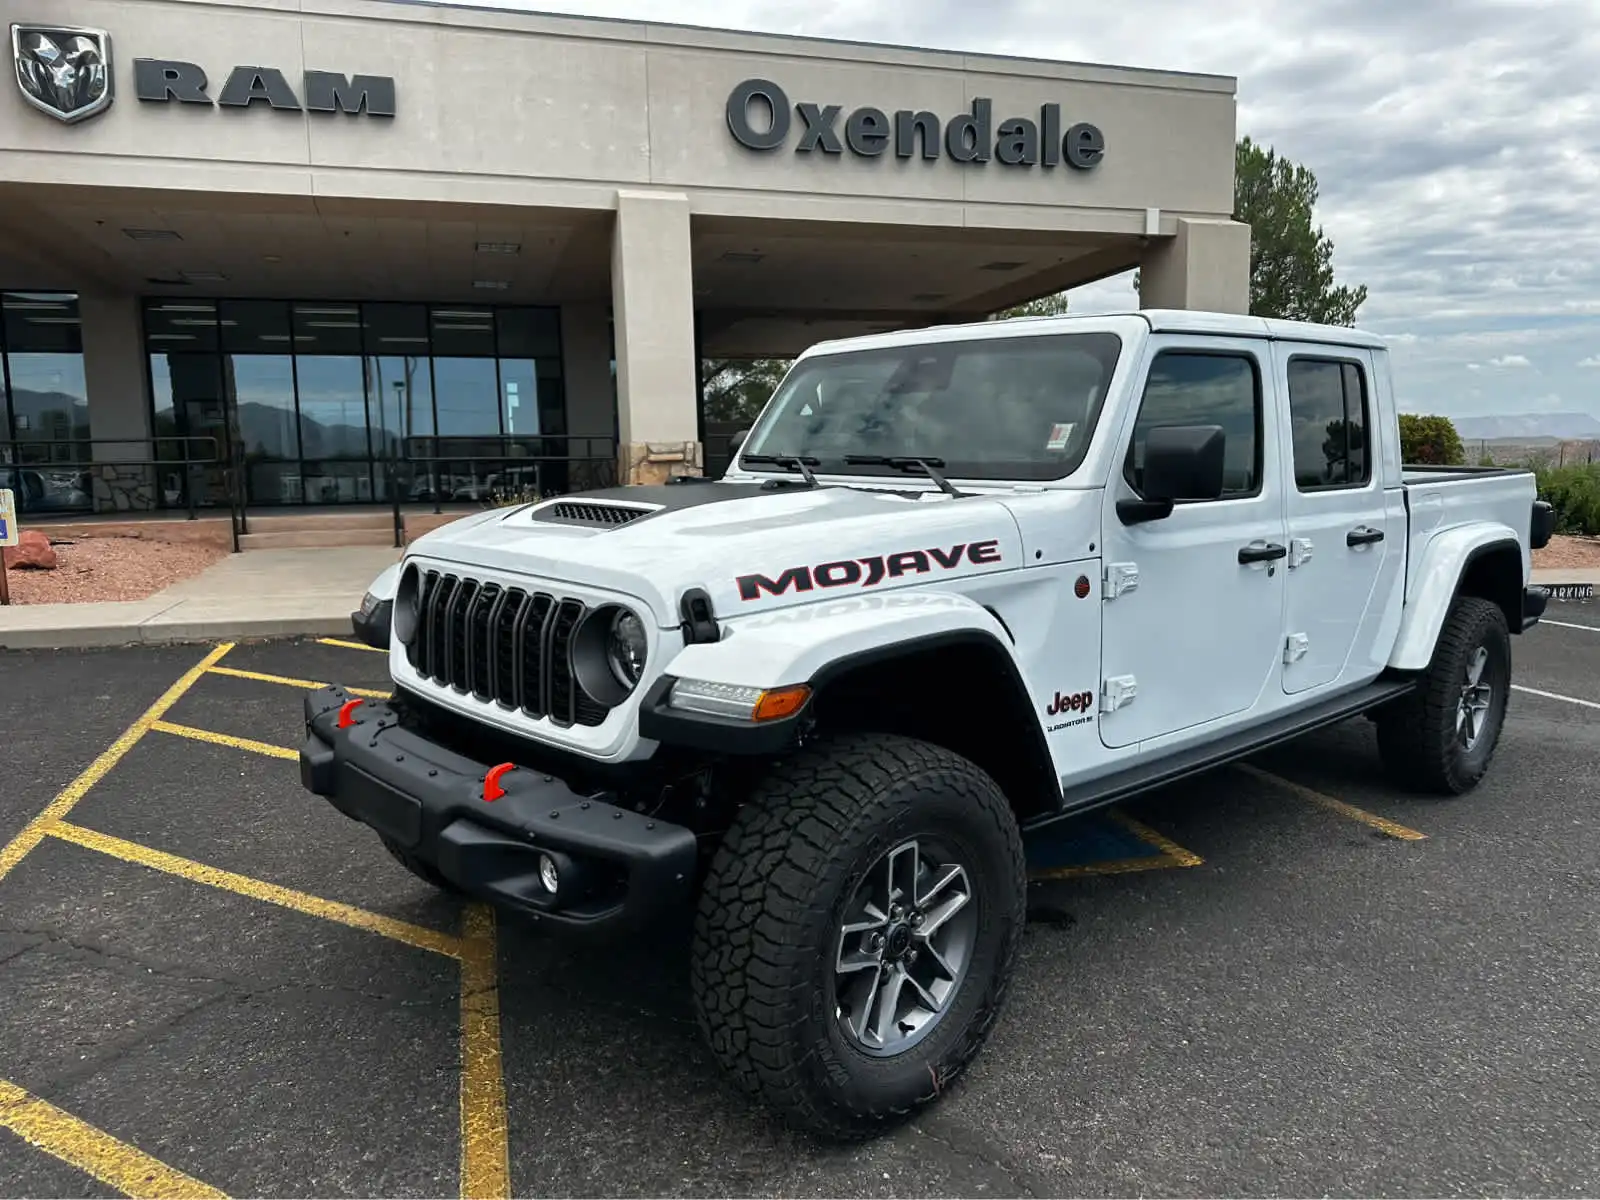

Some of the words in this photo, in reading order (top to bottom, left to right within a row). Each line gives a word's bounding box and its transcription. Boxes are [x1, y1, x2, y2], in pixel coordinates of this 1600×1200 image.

[133, 57, 396, 117] RAM
[726, 78, 1104, 169] Oxendale
[735, 539, 1002, 601] MOJAVE
[1047, 691, 1093, 715] Jeep
